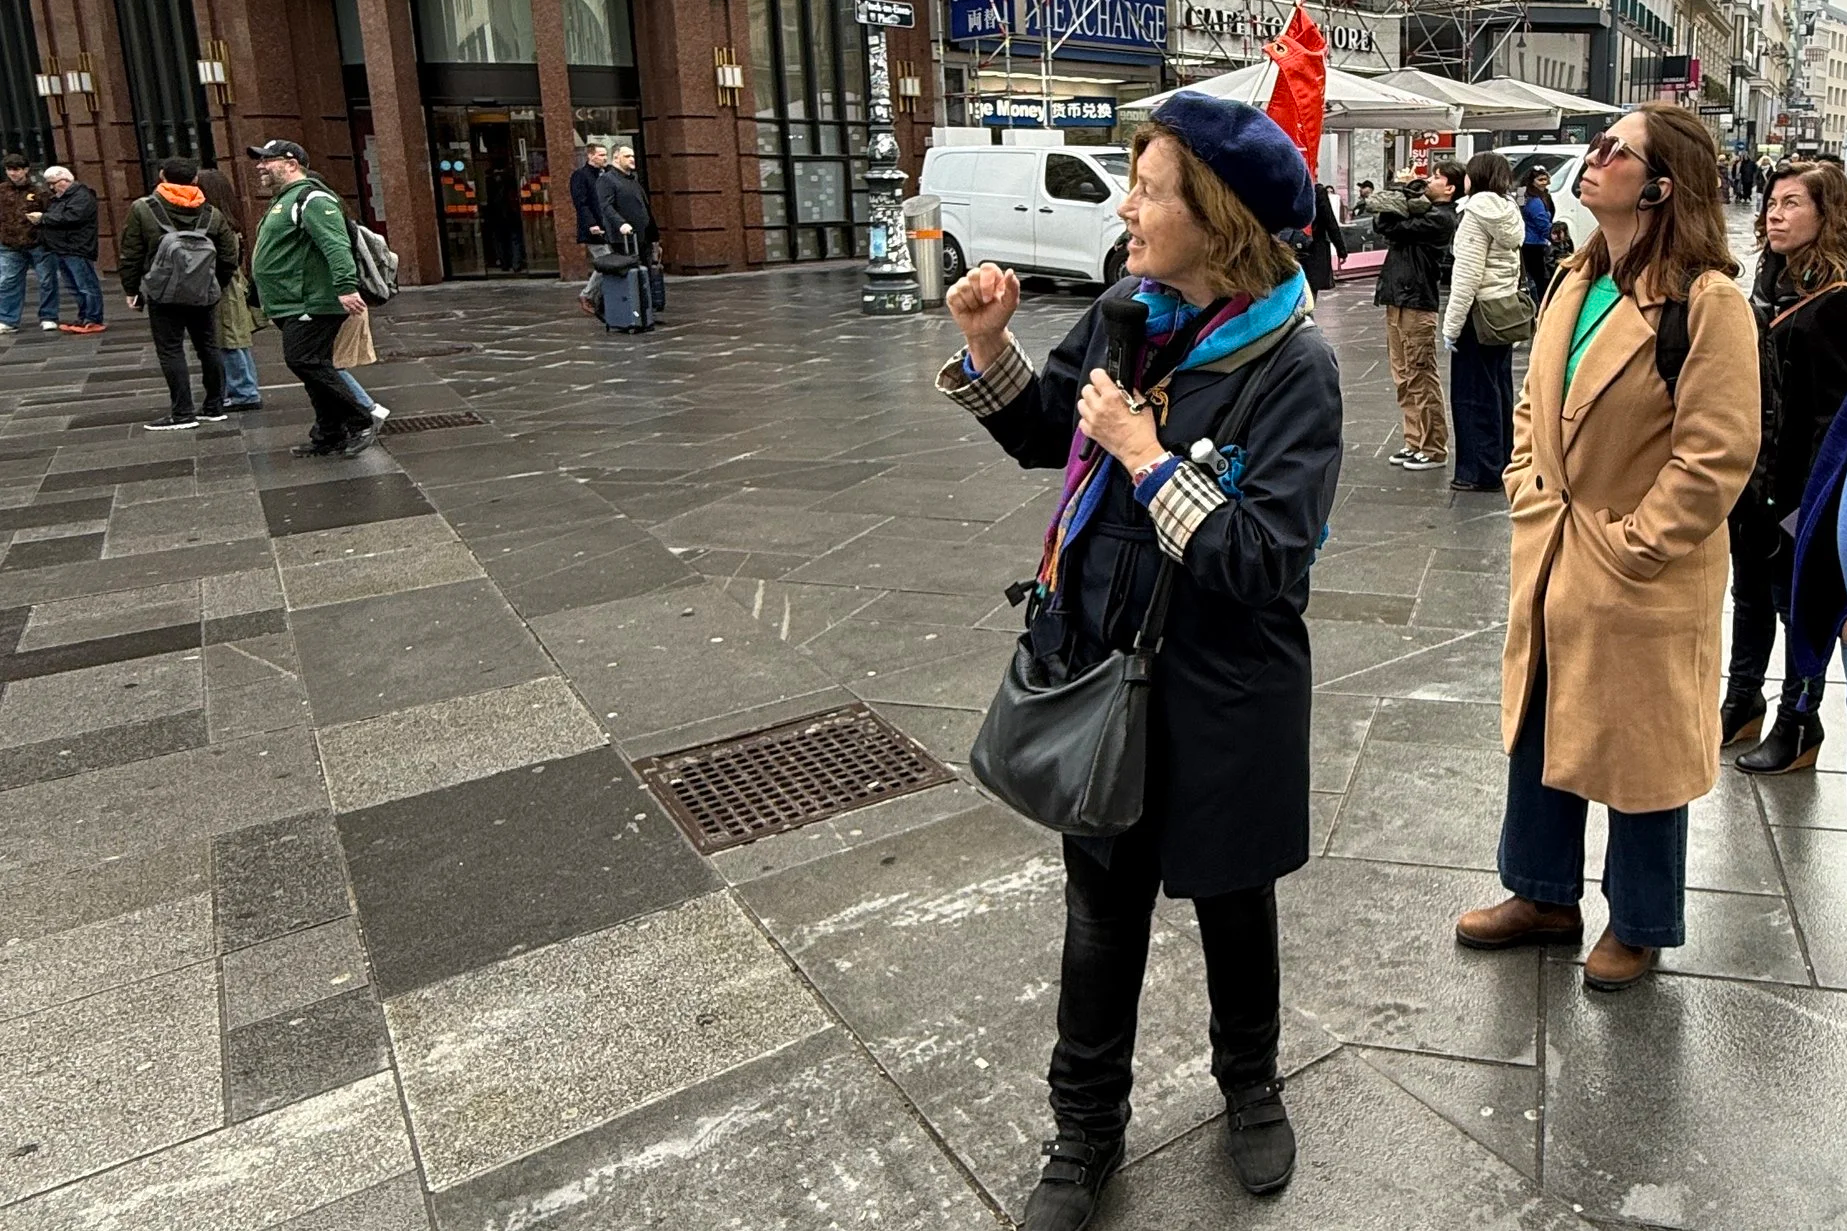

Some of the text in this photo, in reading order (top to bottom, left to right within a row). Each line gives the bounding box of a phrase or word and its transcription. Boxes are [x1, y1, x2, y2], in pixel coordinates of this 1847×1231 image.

[997, 99, 1044, 123] Money
[1052, 102, 1113, 119] 货币兑换
